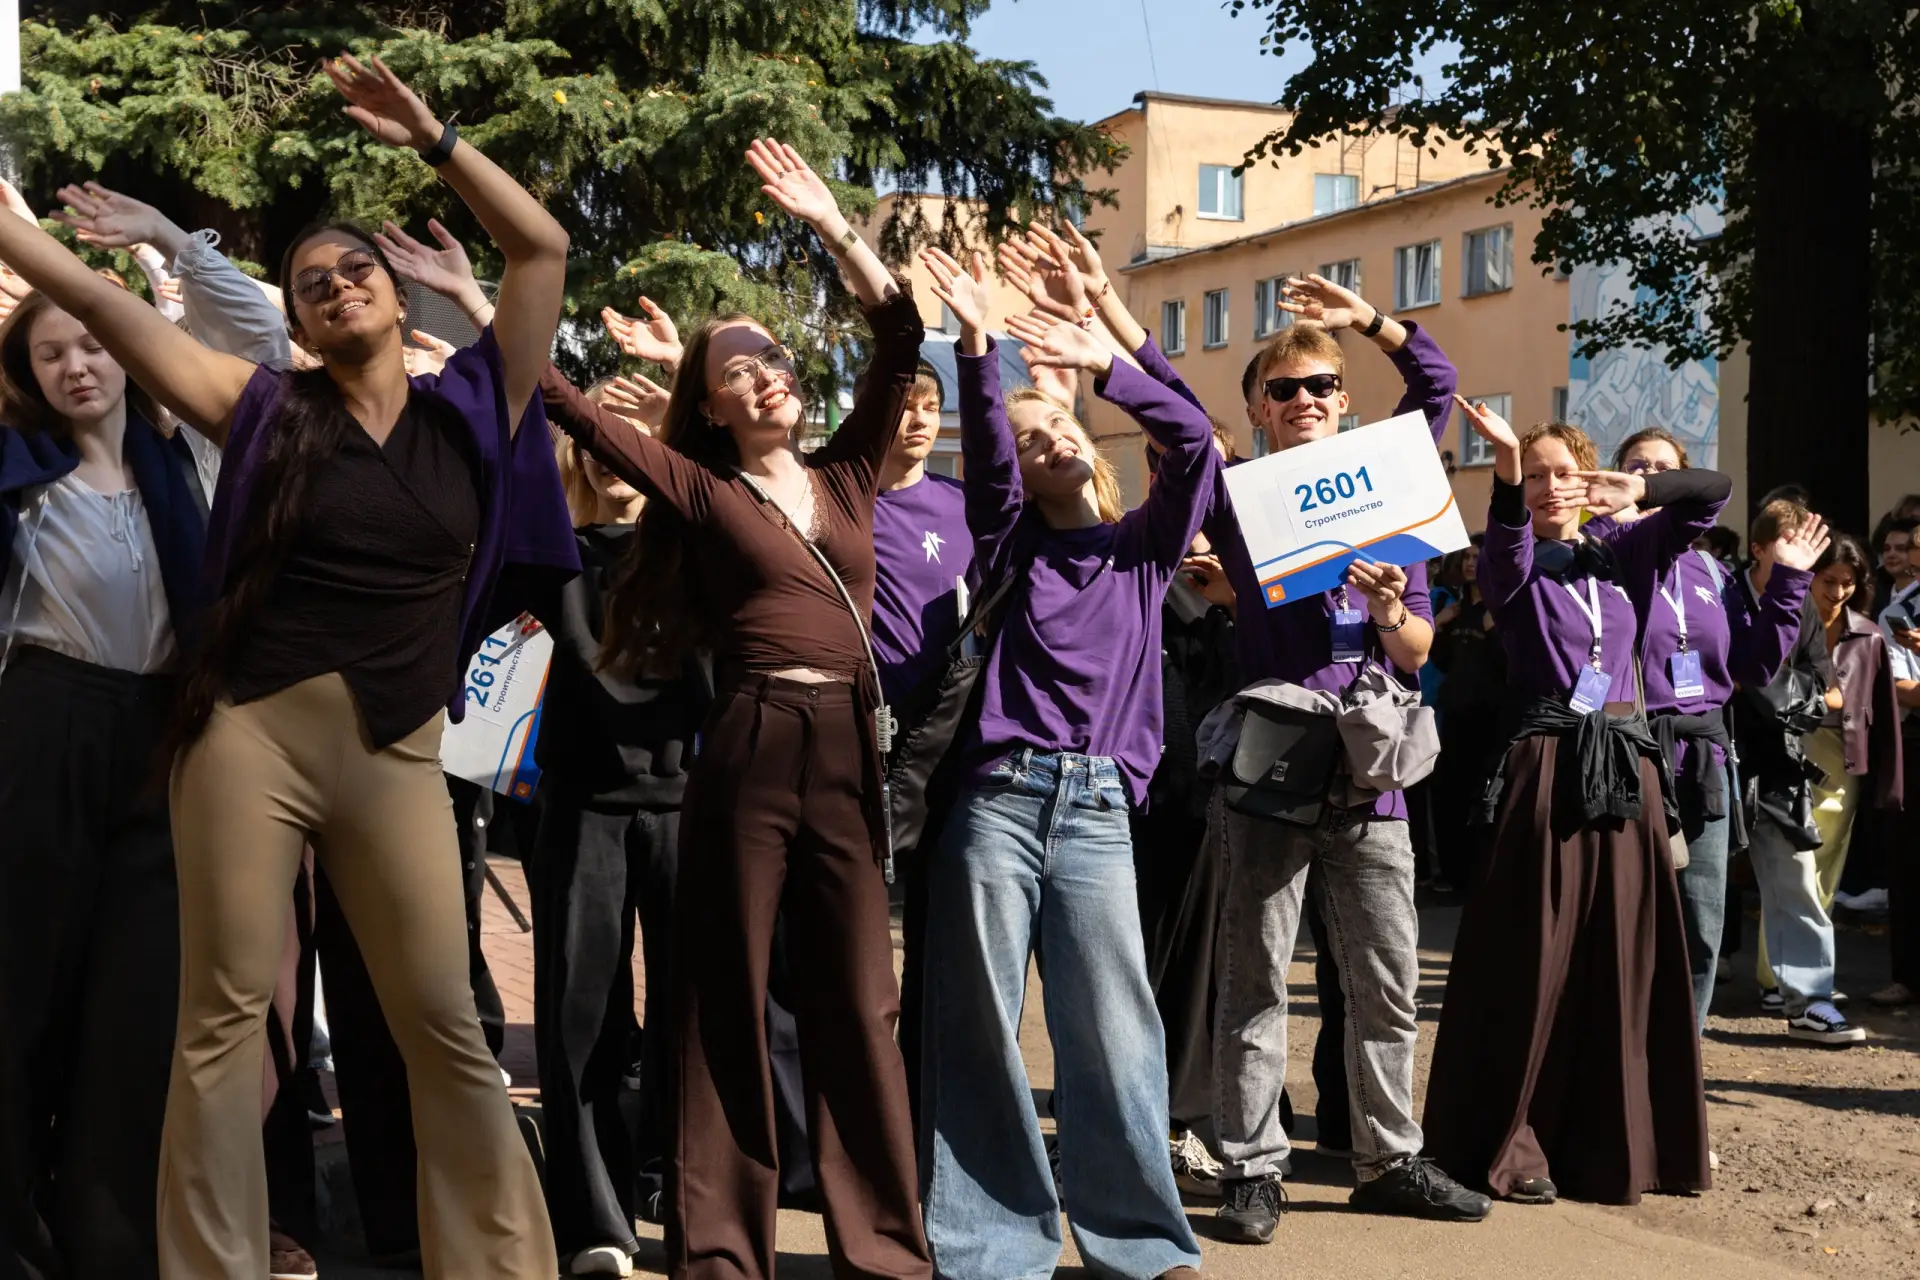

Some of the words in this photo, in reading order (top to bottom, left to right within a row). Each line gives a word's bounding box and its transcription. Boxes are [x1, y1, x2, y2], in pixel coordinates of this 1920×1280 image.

[1294, 466, 1373, 512] 2601
[1304, 500, 1383, 529] Строительство
[465, 635, 508, 708] 2611
[493, 643, 524, 713] Строительство
